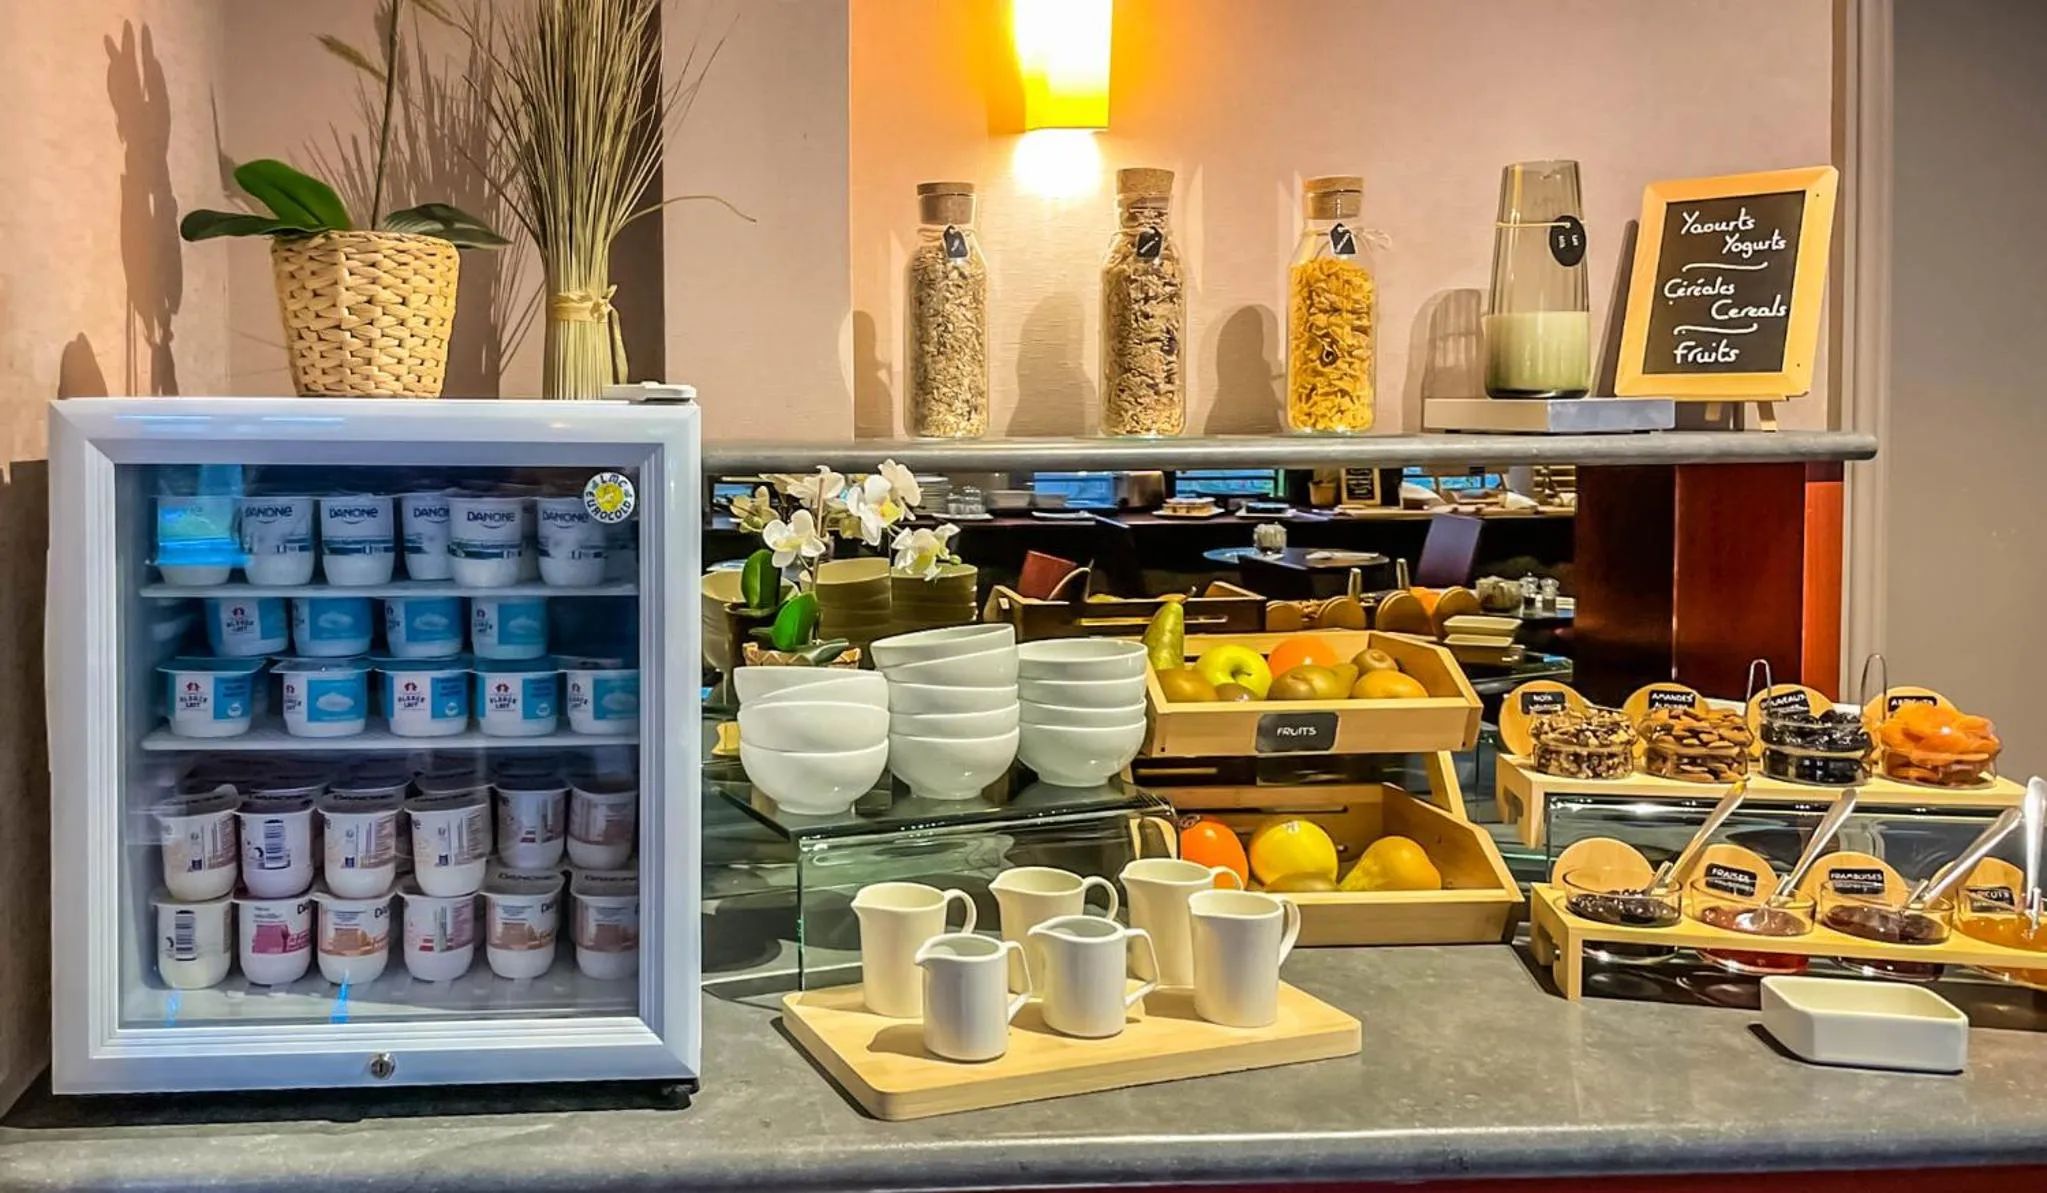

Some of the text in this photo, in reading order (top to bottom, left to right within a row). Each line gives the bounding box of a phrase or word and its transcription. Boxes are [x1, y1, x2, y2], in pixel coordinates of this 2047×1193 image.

[1681, 208, 1756, 235] Yaourts
[1722, 229, 1787, 258] Yogurts
[1711, 295, 1788, 320] Cereals
[245, 505, 293, 518] DANONE
[329, 507, 379, 519] DANONE
[467, 511, 515, 522] DANONE
[542, 511, 589, 523] DANONE
[1276, 726, 1317, 737] FRUITS
